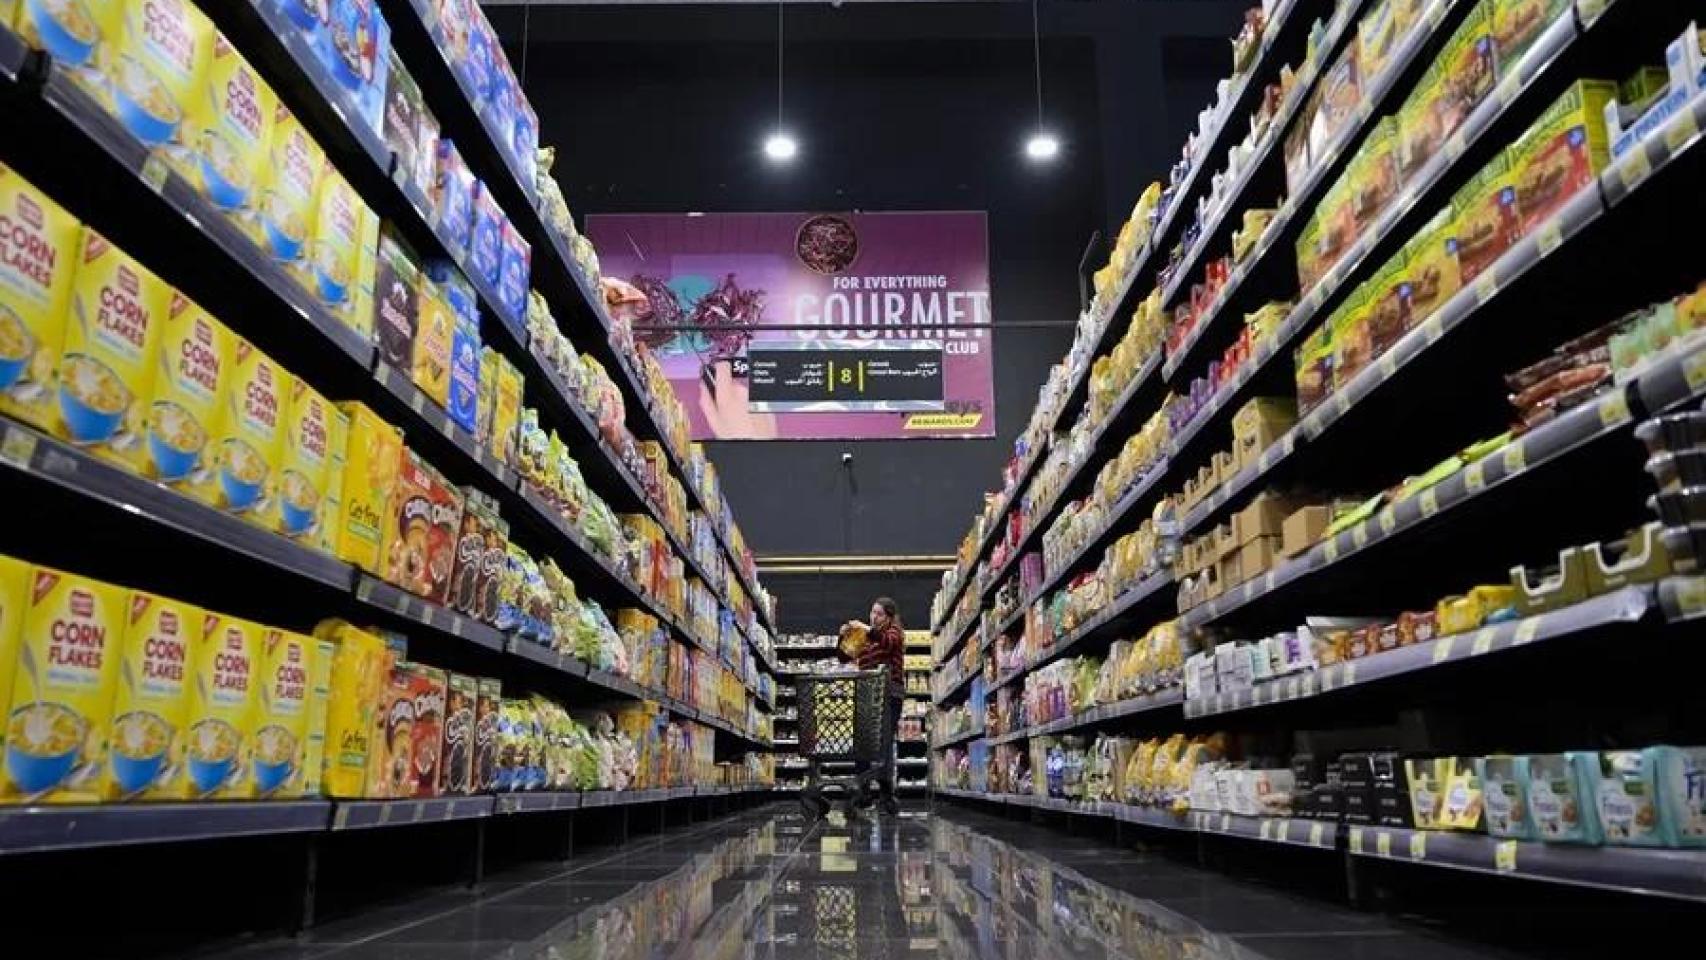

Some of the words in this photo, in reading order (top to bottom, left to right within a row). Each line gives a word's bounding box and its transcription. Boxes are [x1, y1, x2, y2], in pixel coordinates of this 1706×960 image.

[227, 80, 261, 125] CORN
[0, 214, 55, 268] CORN
[0, 241, 51, 288] LAKES
[833, 276, 859, 289] FOR
[864, 275, 947, 288] EVERYTHING
[101, 285, 149, 330] CORN
[794, 290, 990, 339] GOURMET
[97, 308, 145, 347] FLAKES
[182, 338, 219, 375] CORN
[945, 341, 979, 354] CLUB
[180, 359, 217, 392] FLAKES
[733, 360, 750, 374] Sp
[841, 367, 852, 383] 8
[246, 380, 277, 413] CORN
[245, 398, 276, 428] FLAKES
[301, 416, 326, 445] CORN
[51, 618, 106, 649] CORN
[48, 645, 103, 669] FLAKES
[145, 637, 186, 662] CORN
[214, 651, 250, 674] CORN
[143, 660, 183, 681] FLAKES
[213, 672, 248, 690] FLAKES
[276, 664, 306, 682] CORN
[275, 683, 304, 699] FLAKES
